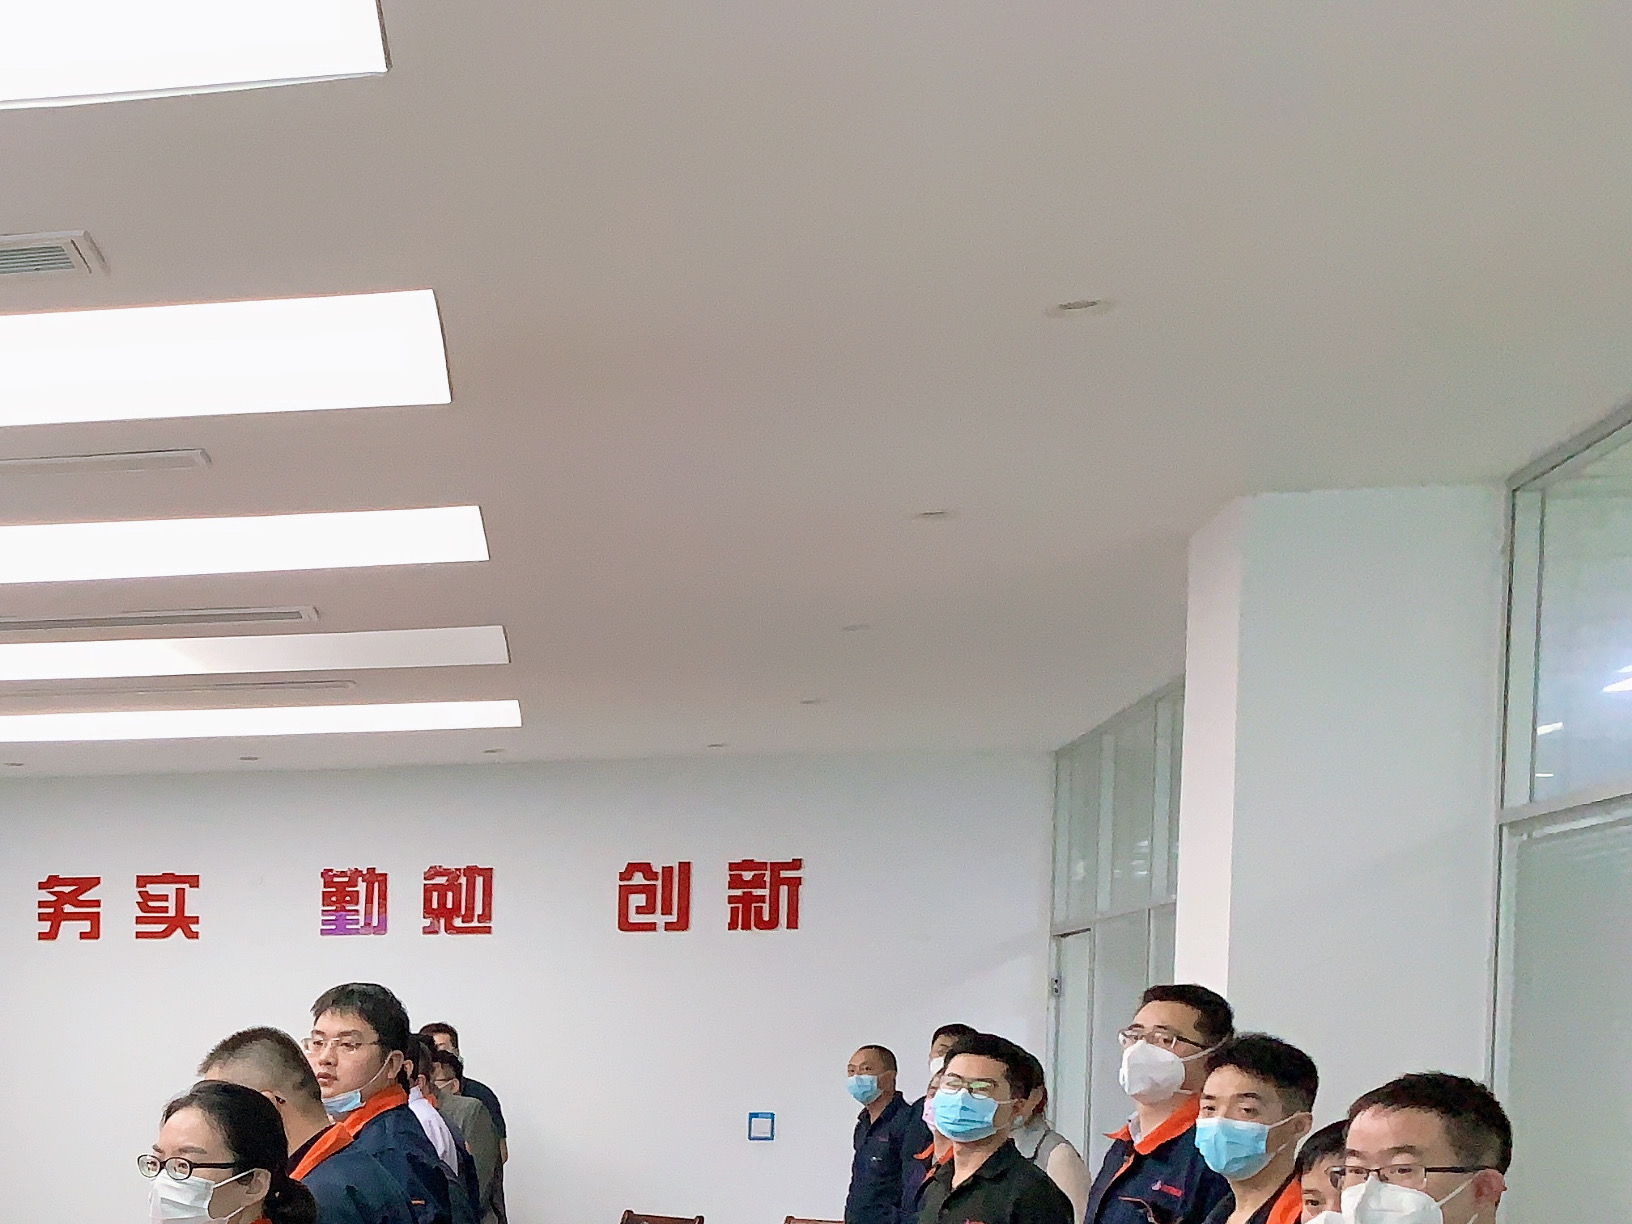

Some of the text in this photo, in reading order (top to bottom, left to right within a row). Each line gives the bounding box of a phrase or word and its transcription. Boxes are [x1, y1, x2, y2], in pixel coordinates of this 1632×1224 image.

[37, 874, 200, 941] 务实
[320, 867, 493, 937] 勤勉
[617, 859, 802, 933] 创新
